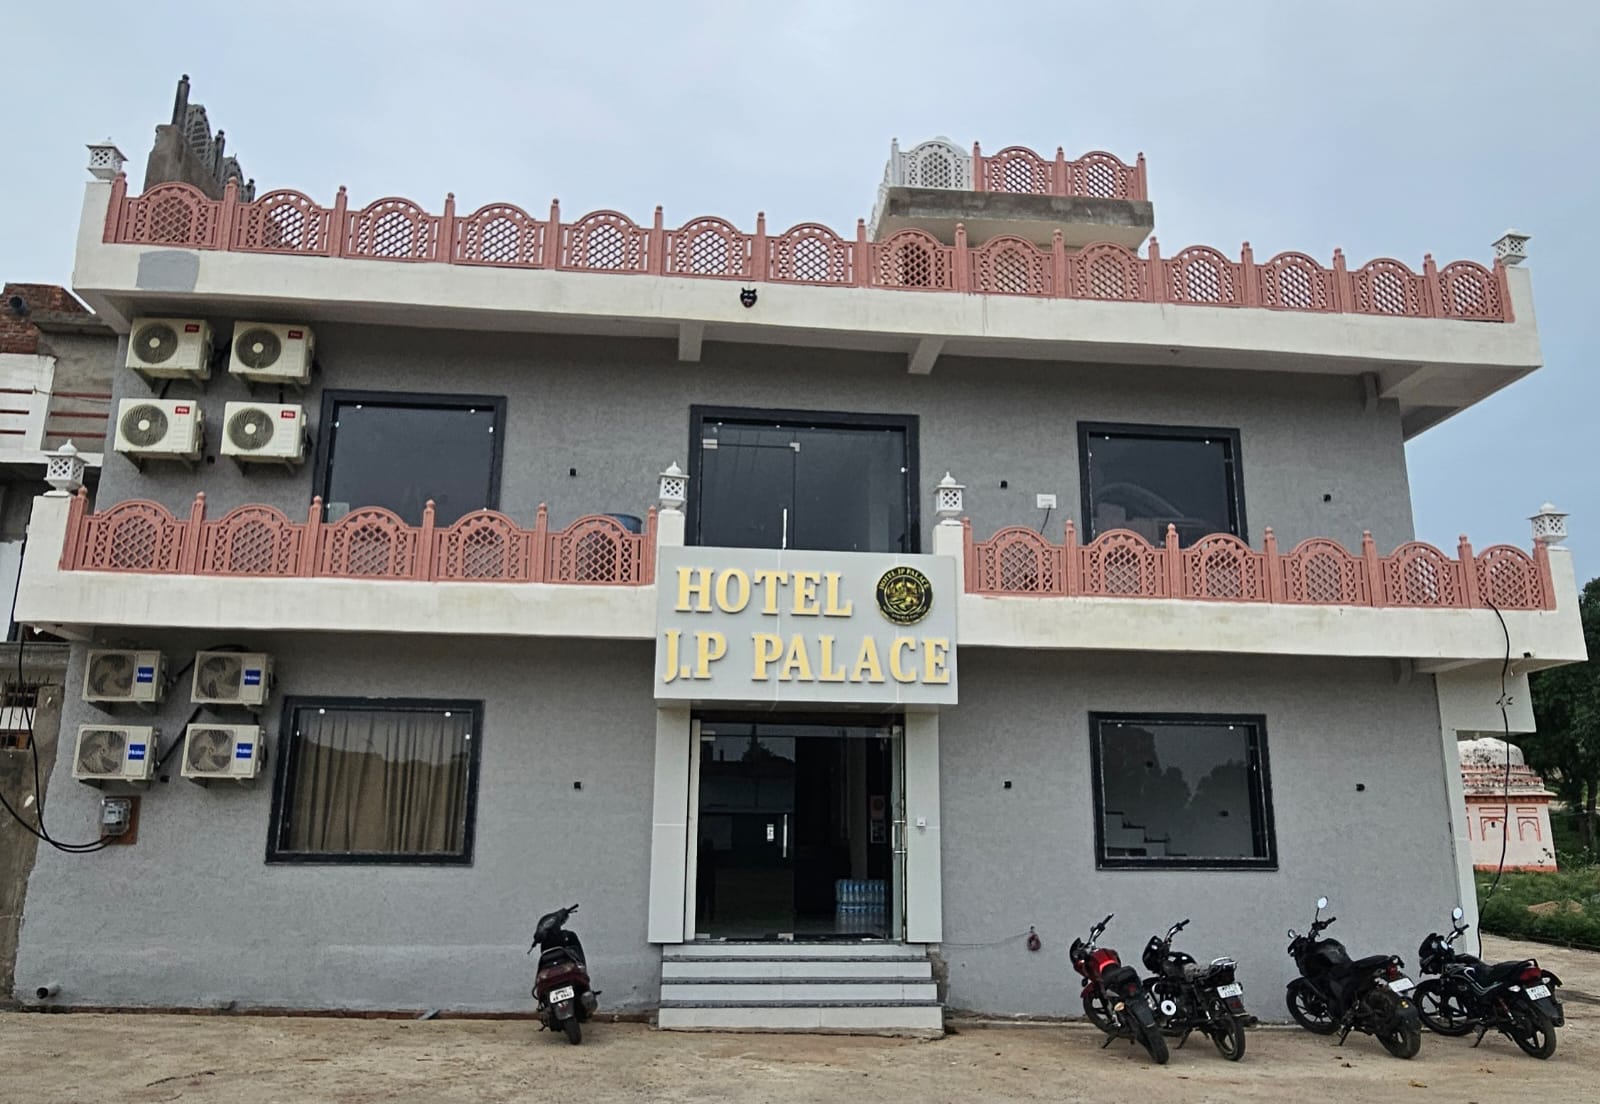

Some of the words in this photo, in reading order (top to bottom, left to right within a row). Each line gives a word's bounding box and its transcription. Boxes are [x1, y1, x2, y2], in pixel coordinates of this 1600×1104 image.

[675, 566, 853, 617] HOTEL
[663, 629, 728, 683] J.P
[751, 633, 950, 684] PALACE
